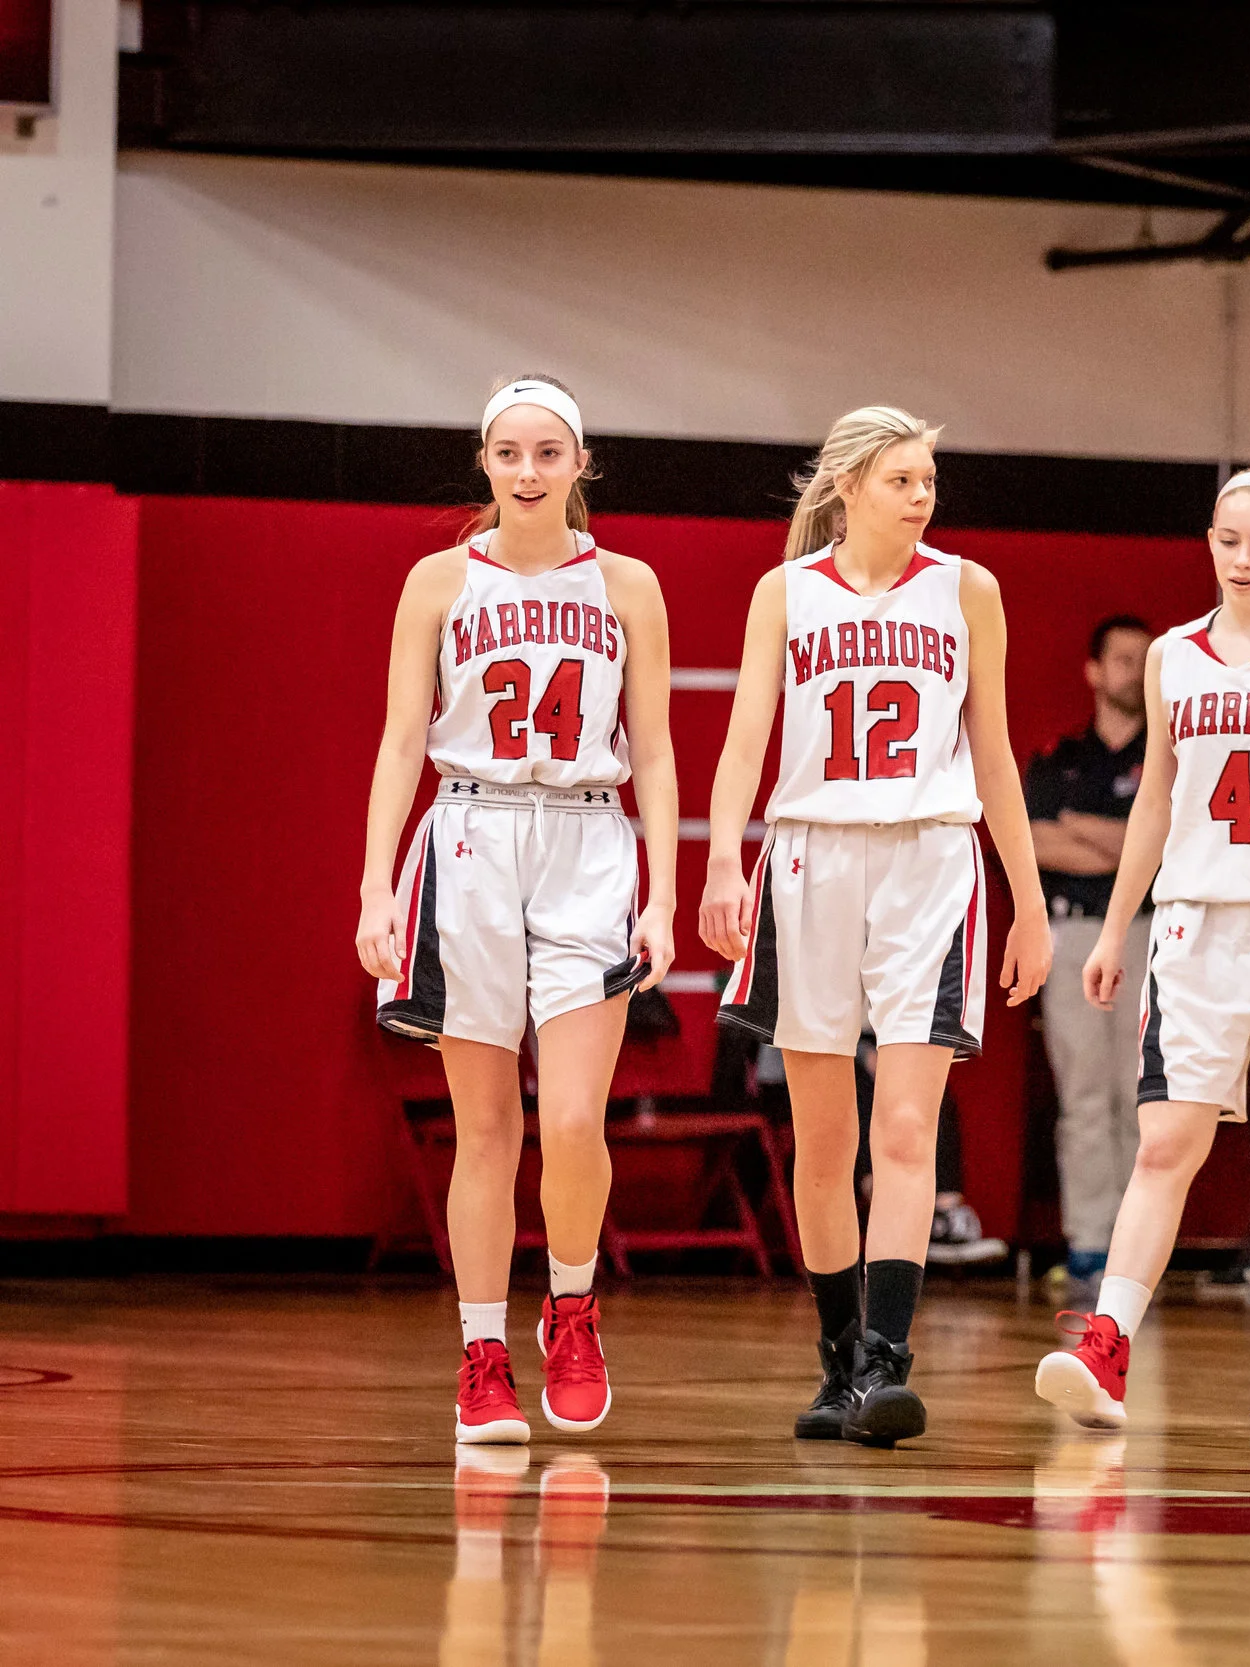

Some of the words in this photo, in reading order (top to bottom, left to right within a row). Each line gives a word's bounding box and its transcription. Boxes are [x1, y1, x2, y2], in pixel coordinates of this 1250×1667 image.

[452, 600, 618, 667] WARRIORS
[788, 620, 957, 686] WARRIORS
[482, 658, 584, 761] 24
[823, 680, 921, 781] 12
